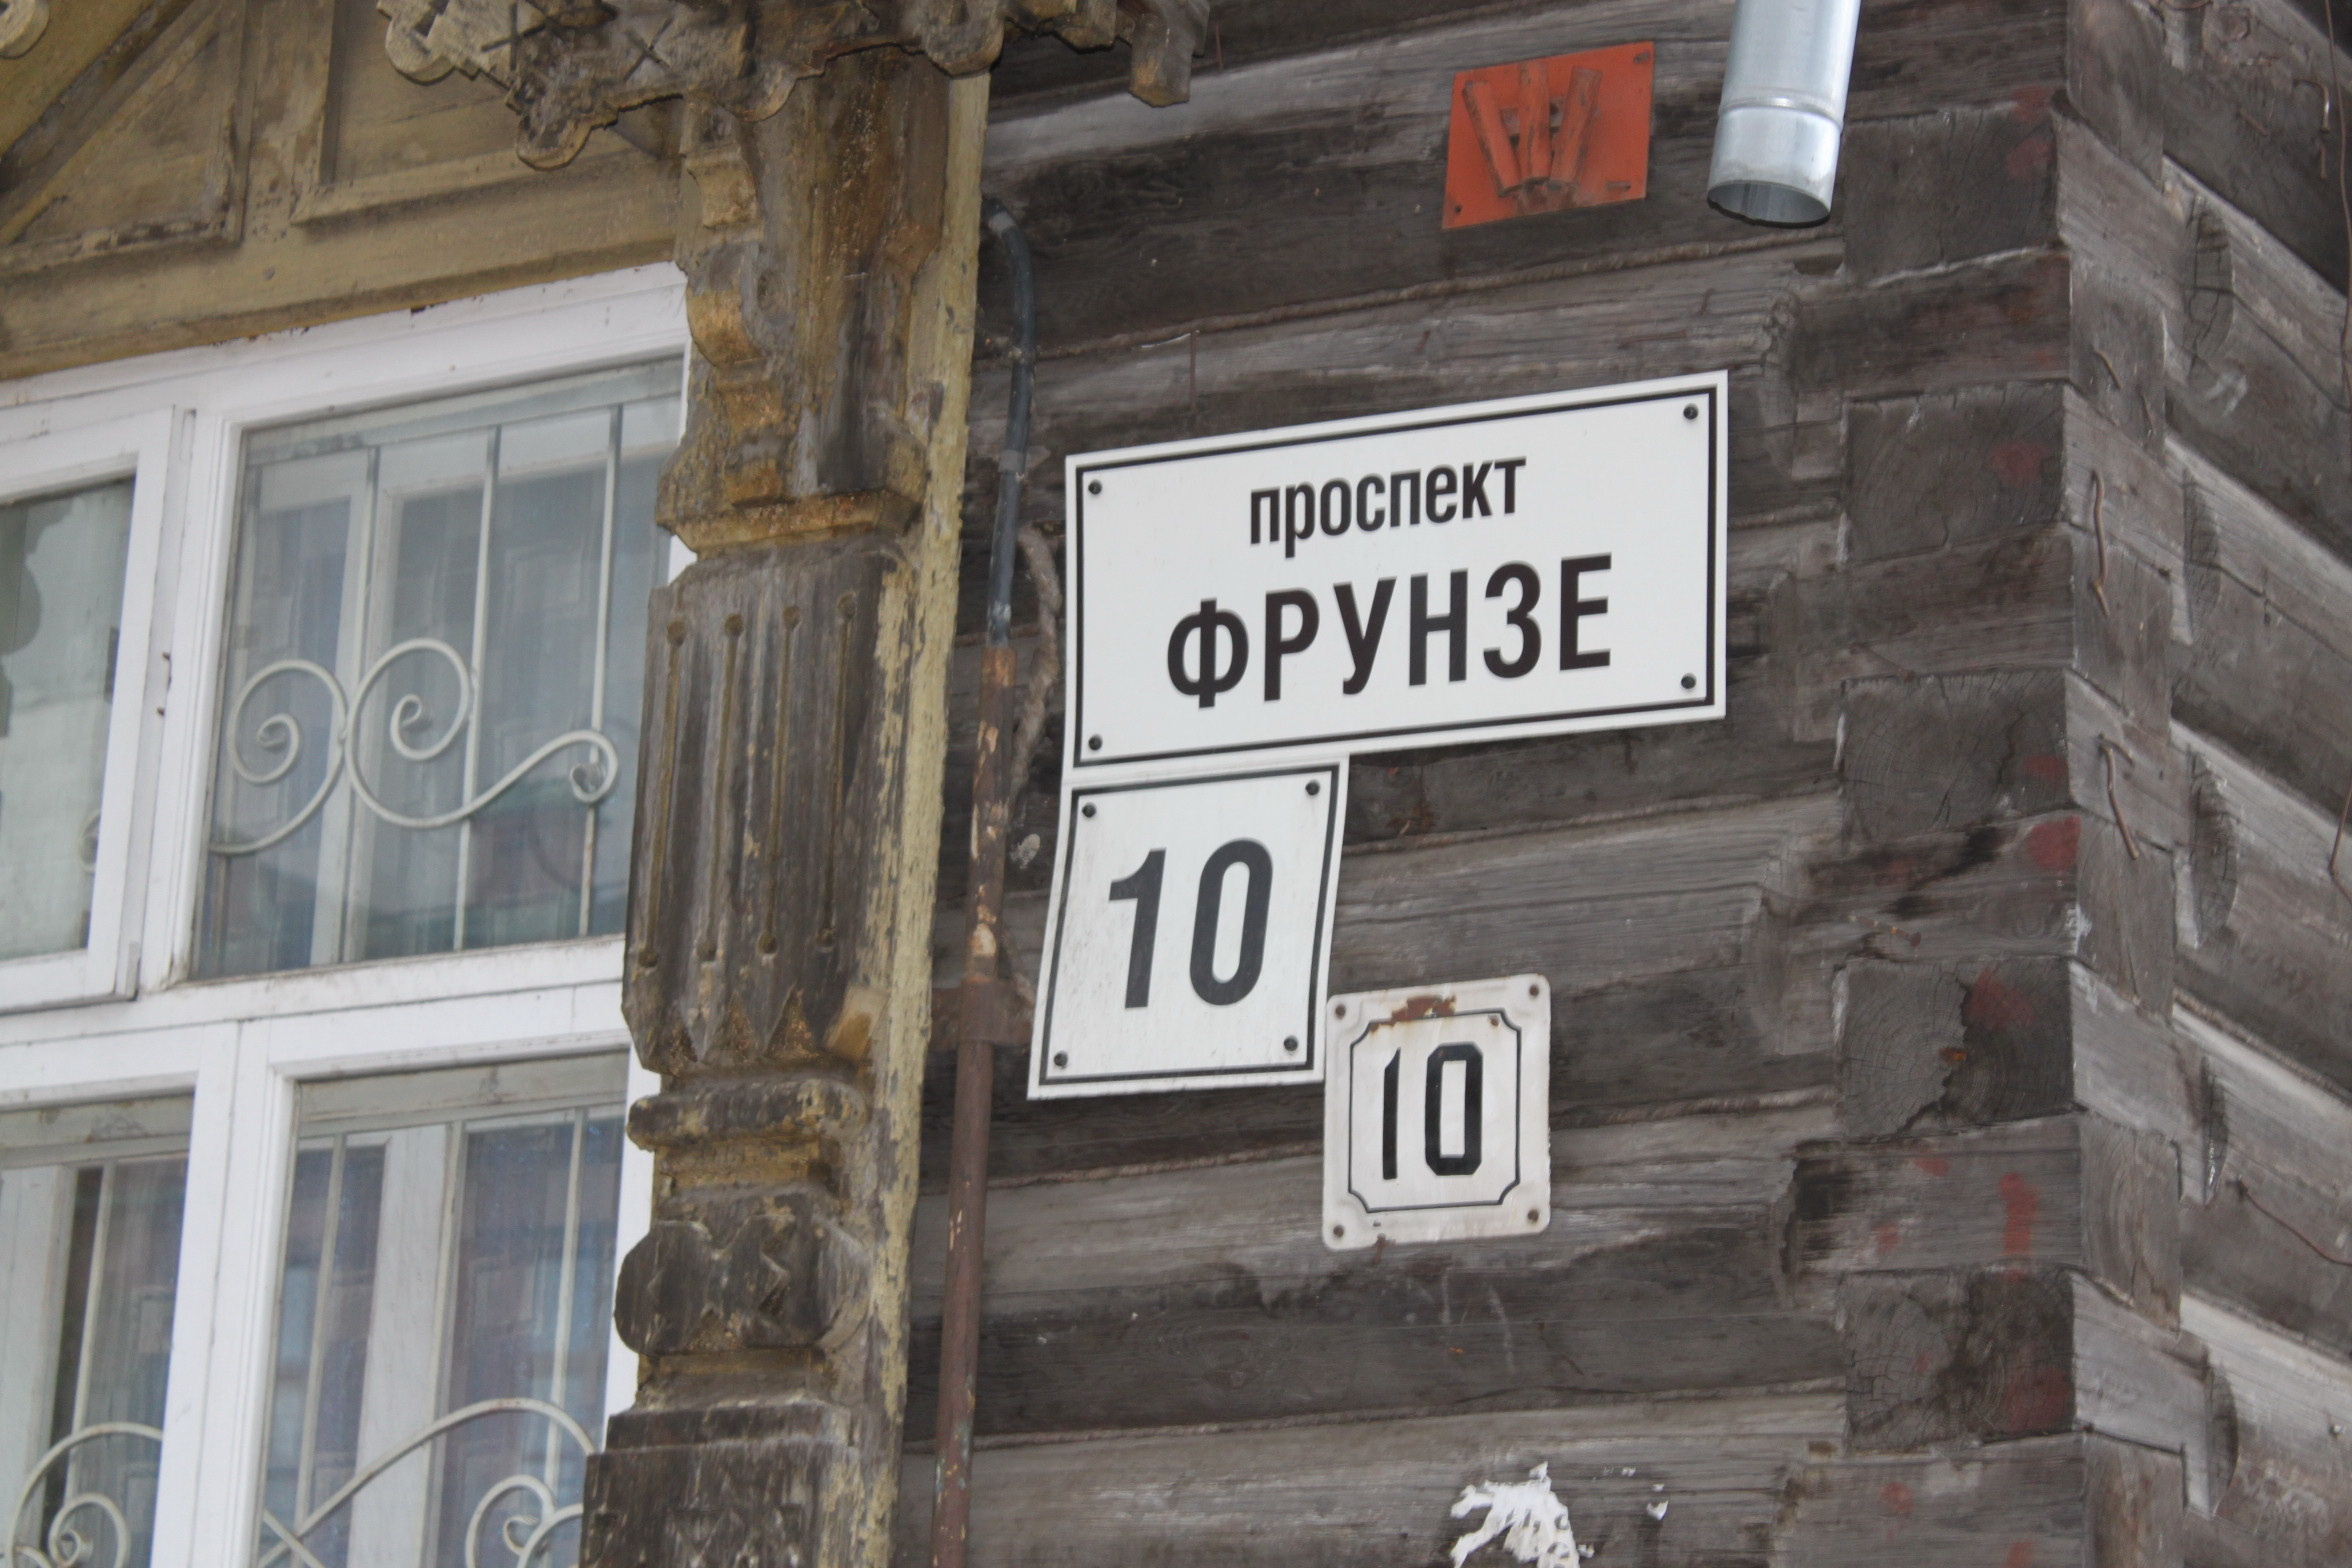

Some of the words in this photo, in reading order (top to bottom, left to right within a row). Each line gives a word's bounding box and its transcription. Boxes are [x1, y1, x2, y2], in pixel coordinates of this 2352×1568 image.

[1250, 457, 1526, 560] проспект
[1166, 553, 1612, 710] ФРУНЗЕ
[1108, 838, 1274, 1009] 10
[1382, 1041, 1483, 1180] 10
